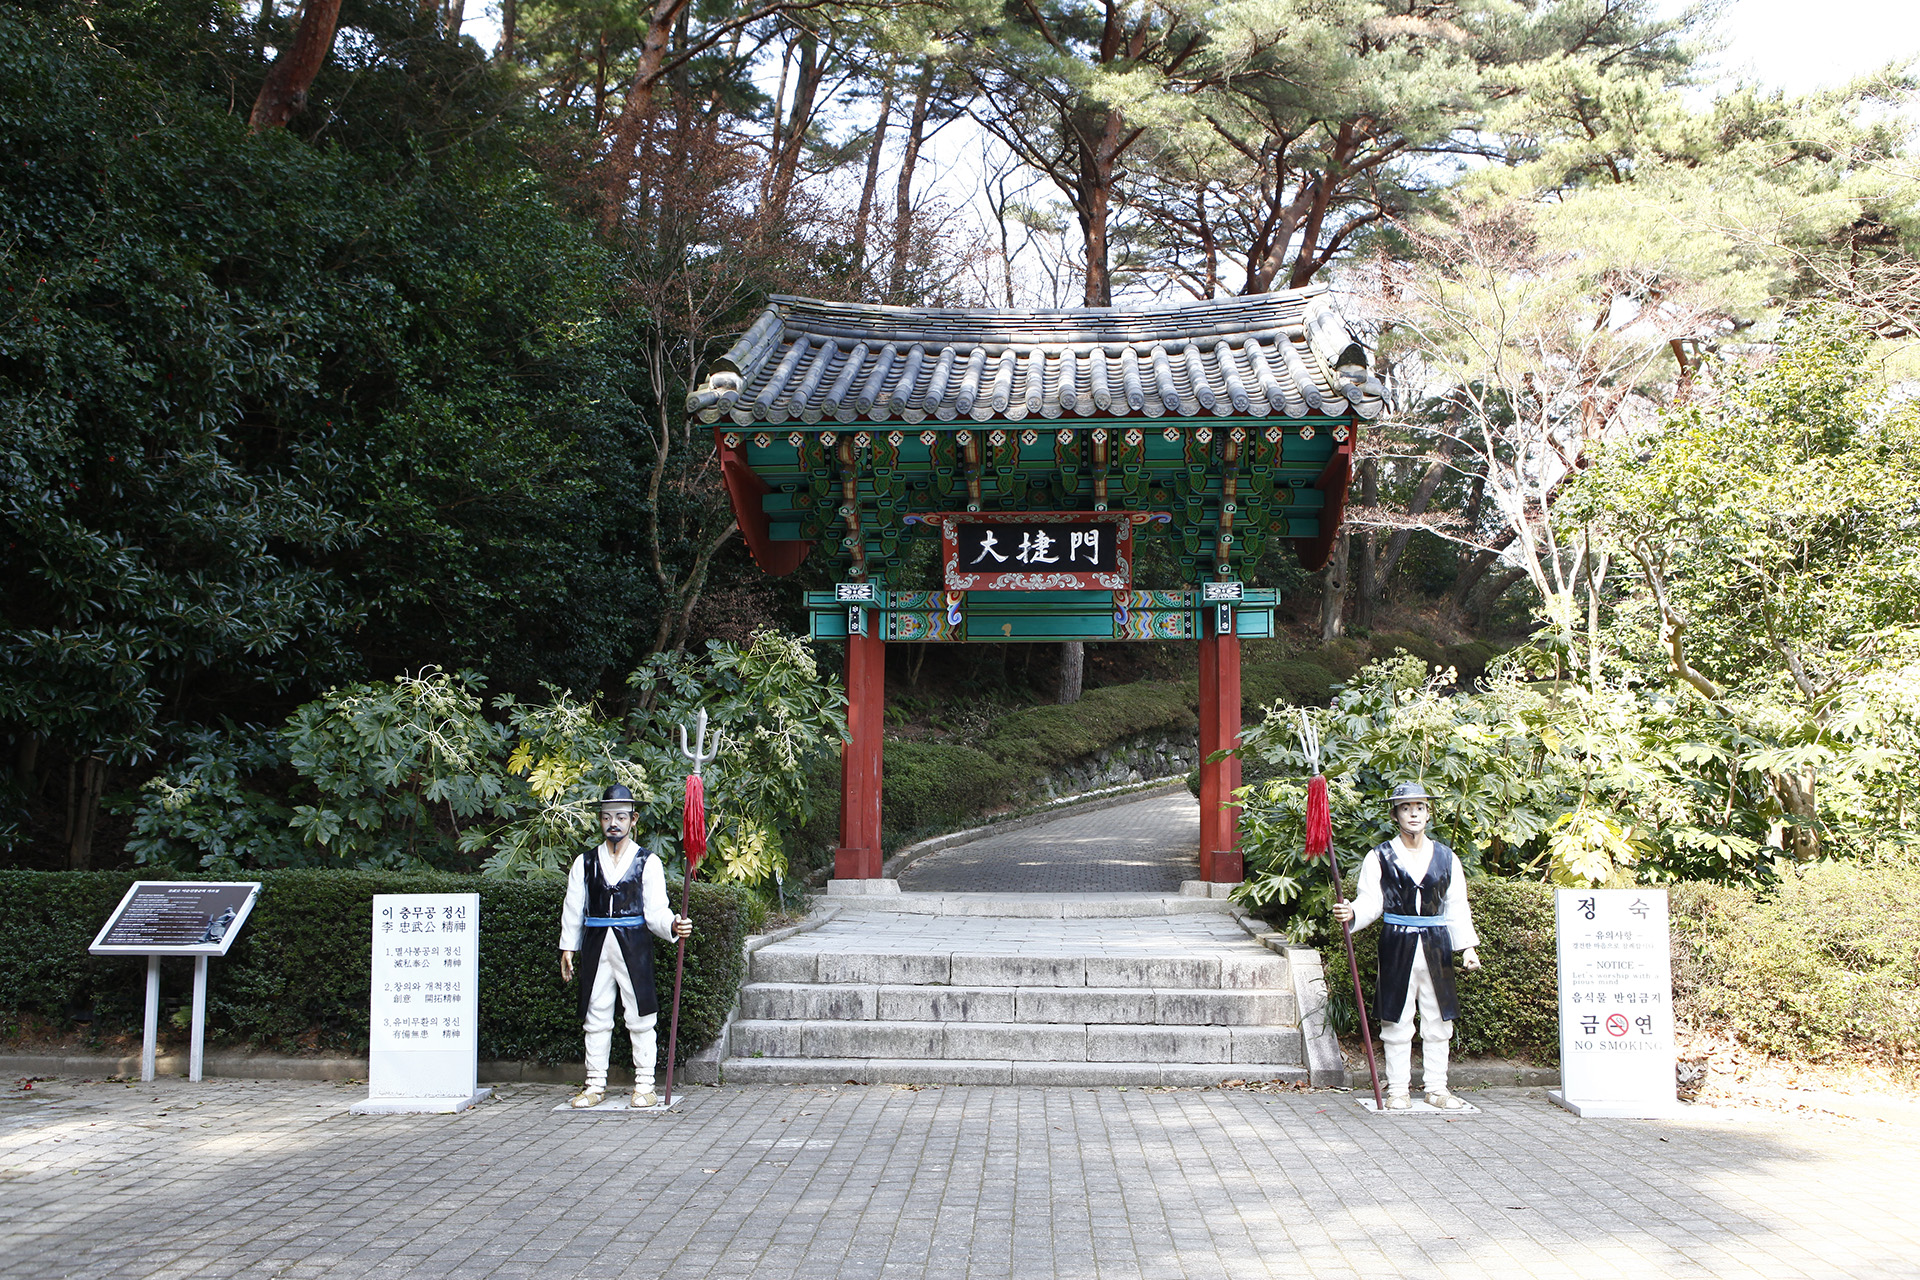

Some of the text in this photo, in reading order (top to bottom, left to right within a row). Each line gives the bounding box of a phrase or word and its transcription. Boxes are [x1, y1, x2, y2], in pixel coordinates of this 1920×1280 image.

[970, 529, 1100, 565] 大捷門
[382, 905, 466, 920] 이 충무공 정신
[1577, 896, 1650, 920] 정 숙
[381, 920, 466, 934] 李 忠武公 精神
[1595, 930, 1632, 941] 유의사항
[444, 946, 461, 957] 정신
[1596, 961, 1634, 970] NOTICE
[1572, 971, 1593, 979] Let's
[1597, 972, 1630, 980] worship
[425, 981, 461, 992] 개척정신
[1571, 991, 1661, 1004] 음식물 반입금지
[442, 1016, 460, 1027] 정신
[1580, 1014, 1653, 1035] 금 연
[1574, 1040, 1662, 1051] NO SMOKING
